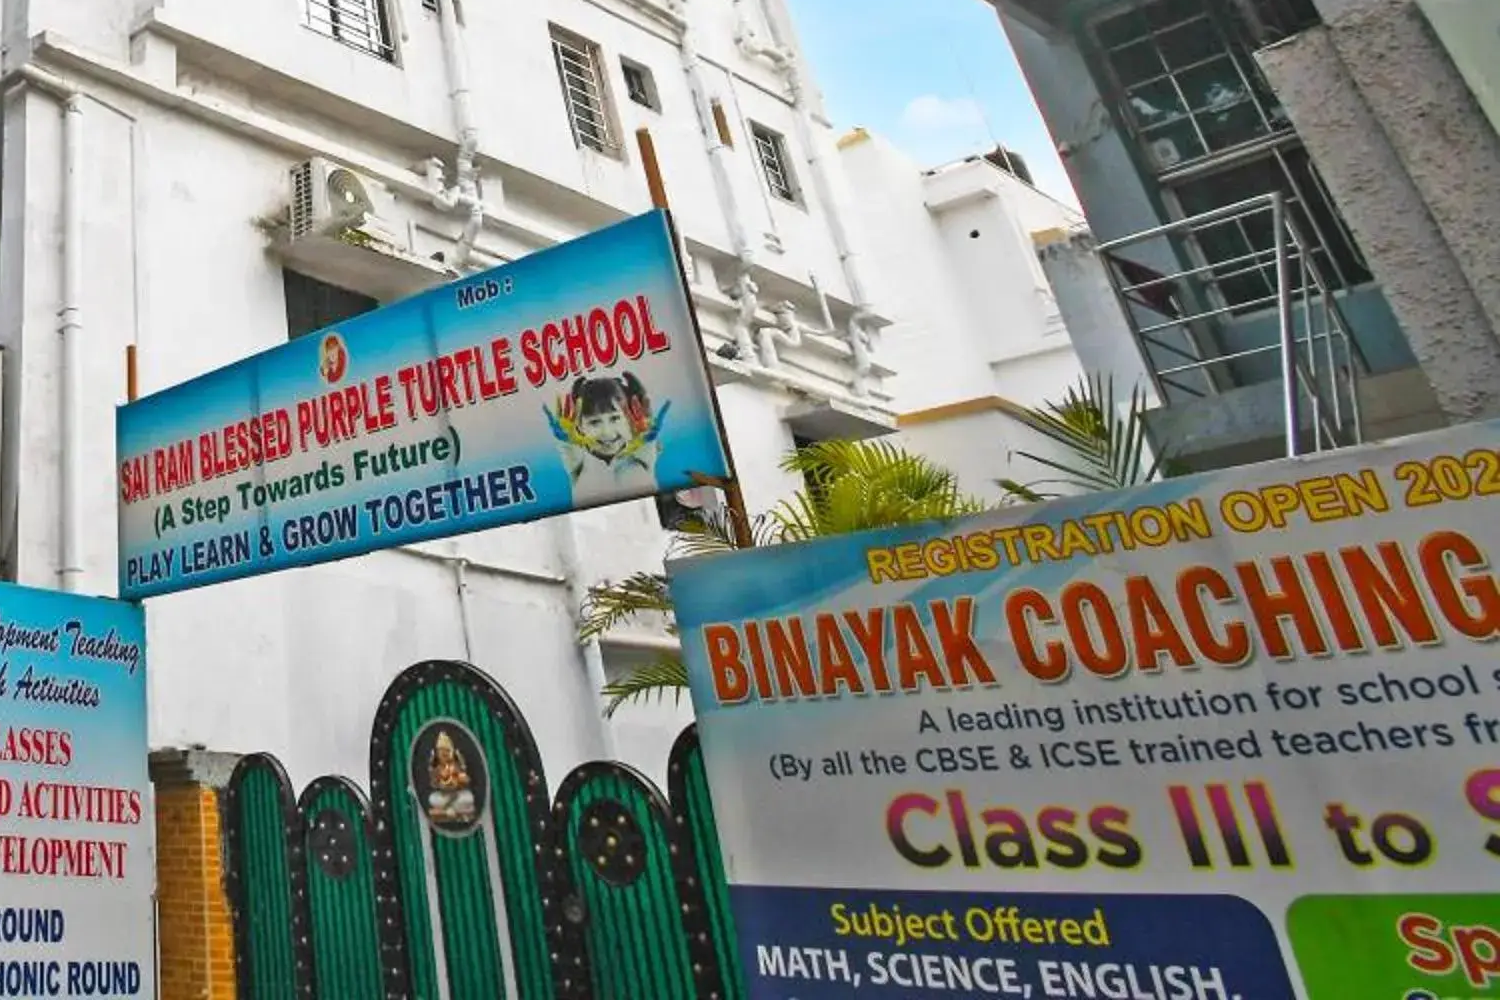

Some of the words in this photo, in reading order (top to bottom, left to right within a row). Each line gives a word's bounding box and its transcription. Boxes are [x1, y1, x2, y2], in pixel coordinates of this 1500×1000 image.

[457, 279, 499, 308] Mob
[121, 455, 150, 504] SAI
[154, 440, 196, 495] RAM
[199, 408, 293, 482] BLESSED
[299, 375, 395, 453] PURPLE
[398, 337, 516, 420] TURTLE
[520, 295, 670, 390] SCHOOL
[182, 496, 231, 524] Step
[236, 462, 345, 511] Towards
[353, 426, 462, 482] Future)
[127, 548, 175, 587] PLAY
[181, 530, 251, 575] LEARN
[259, 525, 275, 557] &
[282, 502, 358, 551] GROW
[365, 465, 534, 534] TOGETHER
[867, 498, 1213, 584] REGISTRATION
[1221, 469, 1390, 534] OPEN
[704, 597, 996, 703] BINAYAK
[1004, 530, 1500, 682] COACHING
[65, 621, 140, 674] Teaching
[13, 665, 101, 708] Activities
[918, 709, 941, 734] A
[947, 704, 1064, 732] leading
[1073, 689, 1257, 724] institution
[1266, 682, 1323, 711] for
[1337, 664, 1481, 705] school
[769, 753, 813, 781] (By
[822, 751, 853, 777] all
[860, 750, 906, 775] the
[915, 746, 1000, 774] CBSE
[1009, 743, 1032, 770] &
[1040, 739, 1122, 768] ICSE
[1128, 730, 1263, 765] trained
[1270, 721, 1455, 757] teachers
[18, 780, 141, 825] ACTIVITIES
[884, 787, 1144, 870] Class
[1167, 780, 1294, 868] III
[1324, 803, 1435, 869] to
[830, 902, 959, 946] Subject
[965, 906, 1110, 945] Offered
[68, 961, 140, 996] ROUND
[757, 944, 861, 988] MATH,
[867, 951, 1032, 999] SCIENCE,
